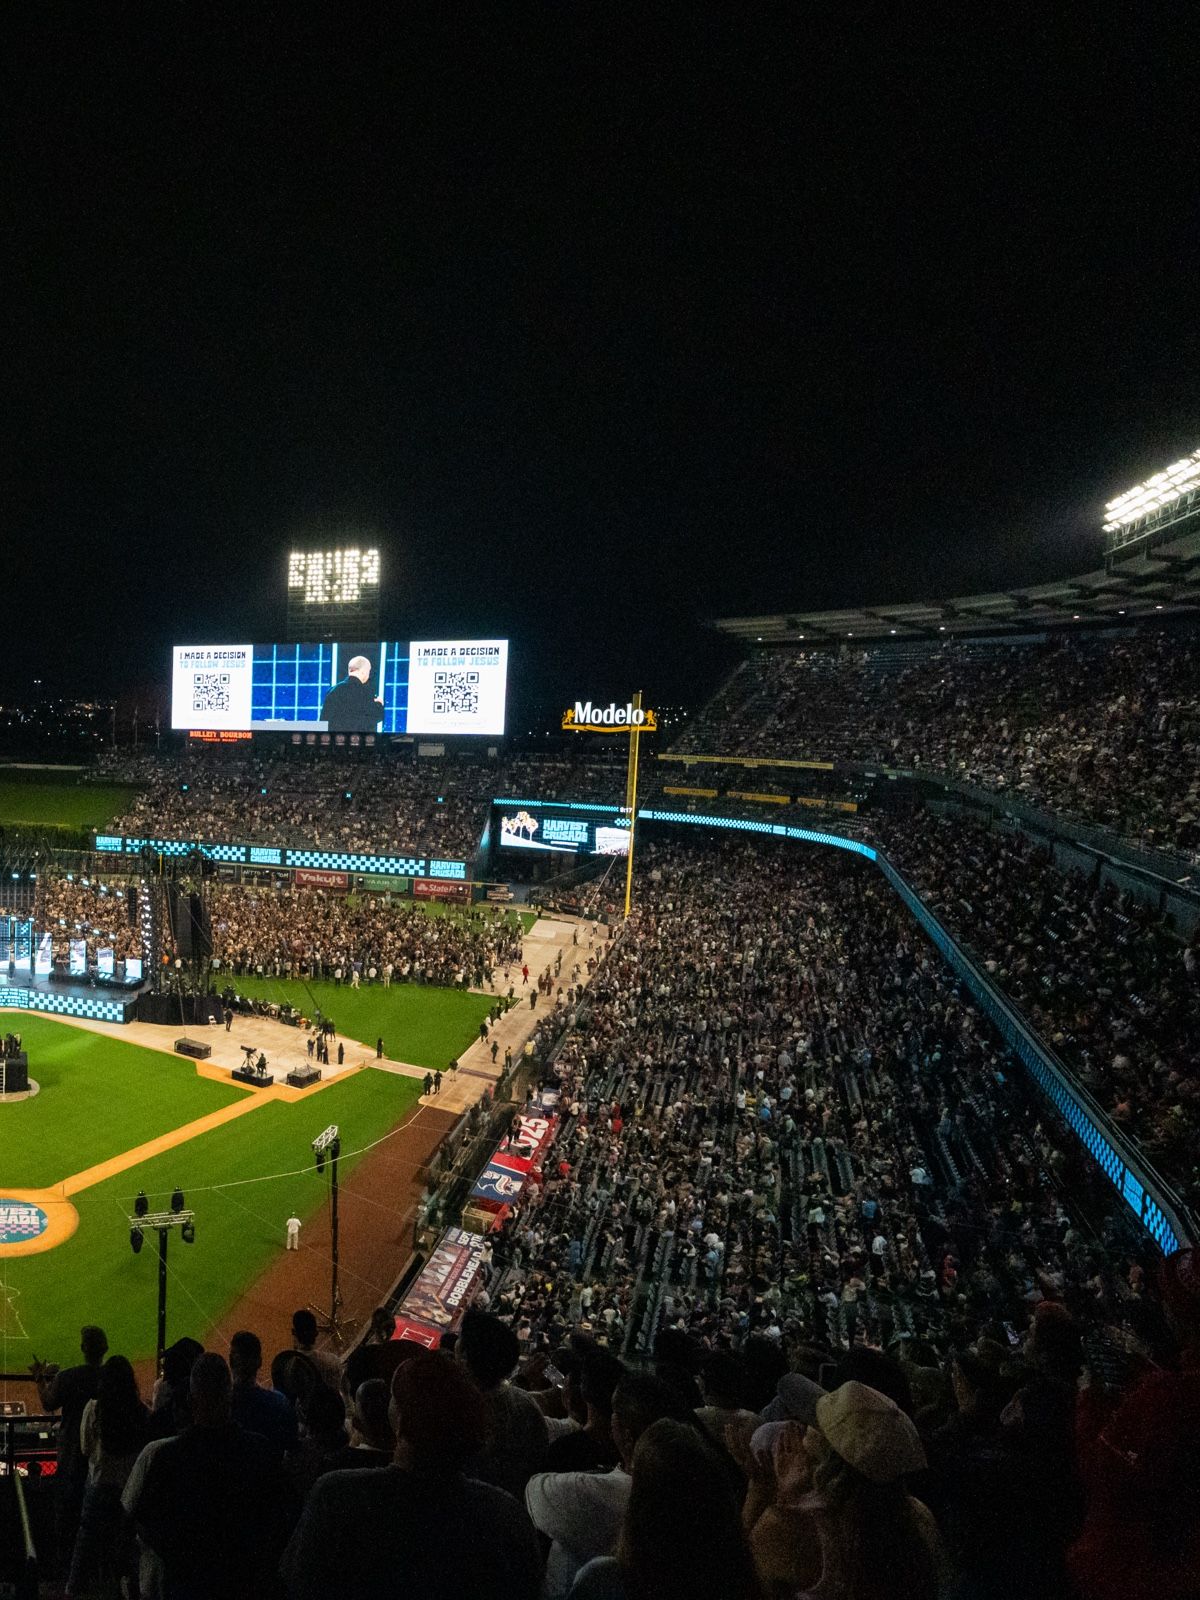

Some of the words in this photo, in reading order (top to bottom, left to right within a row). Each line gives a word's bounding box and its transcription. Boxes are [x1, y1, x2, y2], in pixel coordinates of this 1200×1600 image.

[214, 652, 246, 660] DECISION
[423, 648, 448, 656] MADE
[451, 648, 456, 656] A
[460, 647, 500, 656] DECISION
[191, 660, 218, 668] FOLLOW
[222, 660, 246, 668] JESUS
[418, 657, 428, 666] TO
[432, 656, 466, 666] FOLLOW
[469, 656, 500, 666] JESUS
[574, 701, 645, 725] Modelo
[543, 820, 588, 832] HARVEST
[543, 830, 588, 842] CRUSADE
[251, 848, 281, 856] HARVEST
[251, 855, 281, 864] CRUSADE
[430, 860, 466, 871] HARVEST
[300, 873, 334, 884] Yakult
[430, 869, 466, 879] CRUSADE
[428, 884, 448, 892] State
[446, 1251, 481, 1306] BOBBLEHEAD
